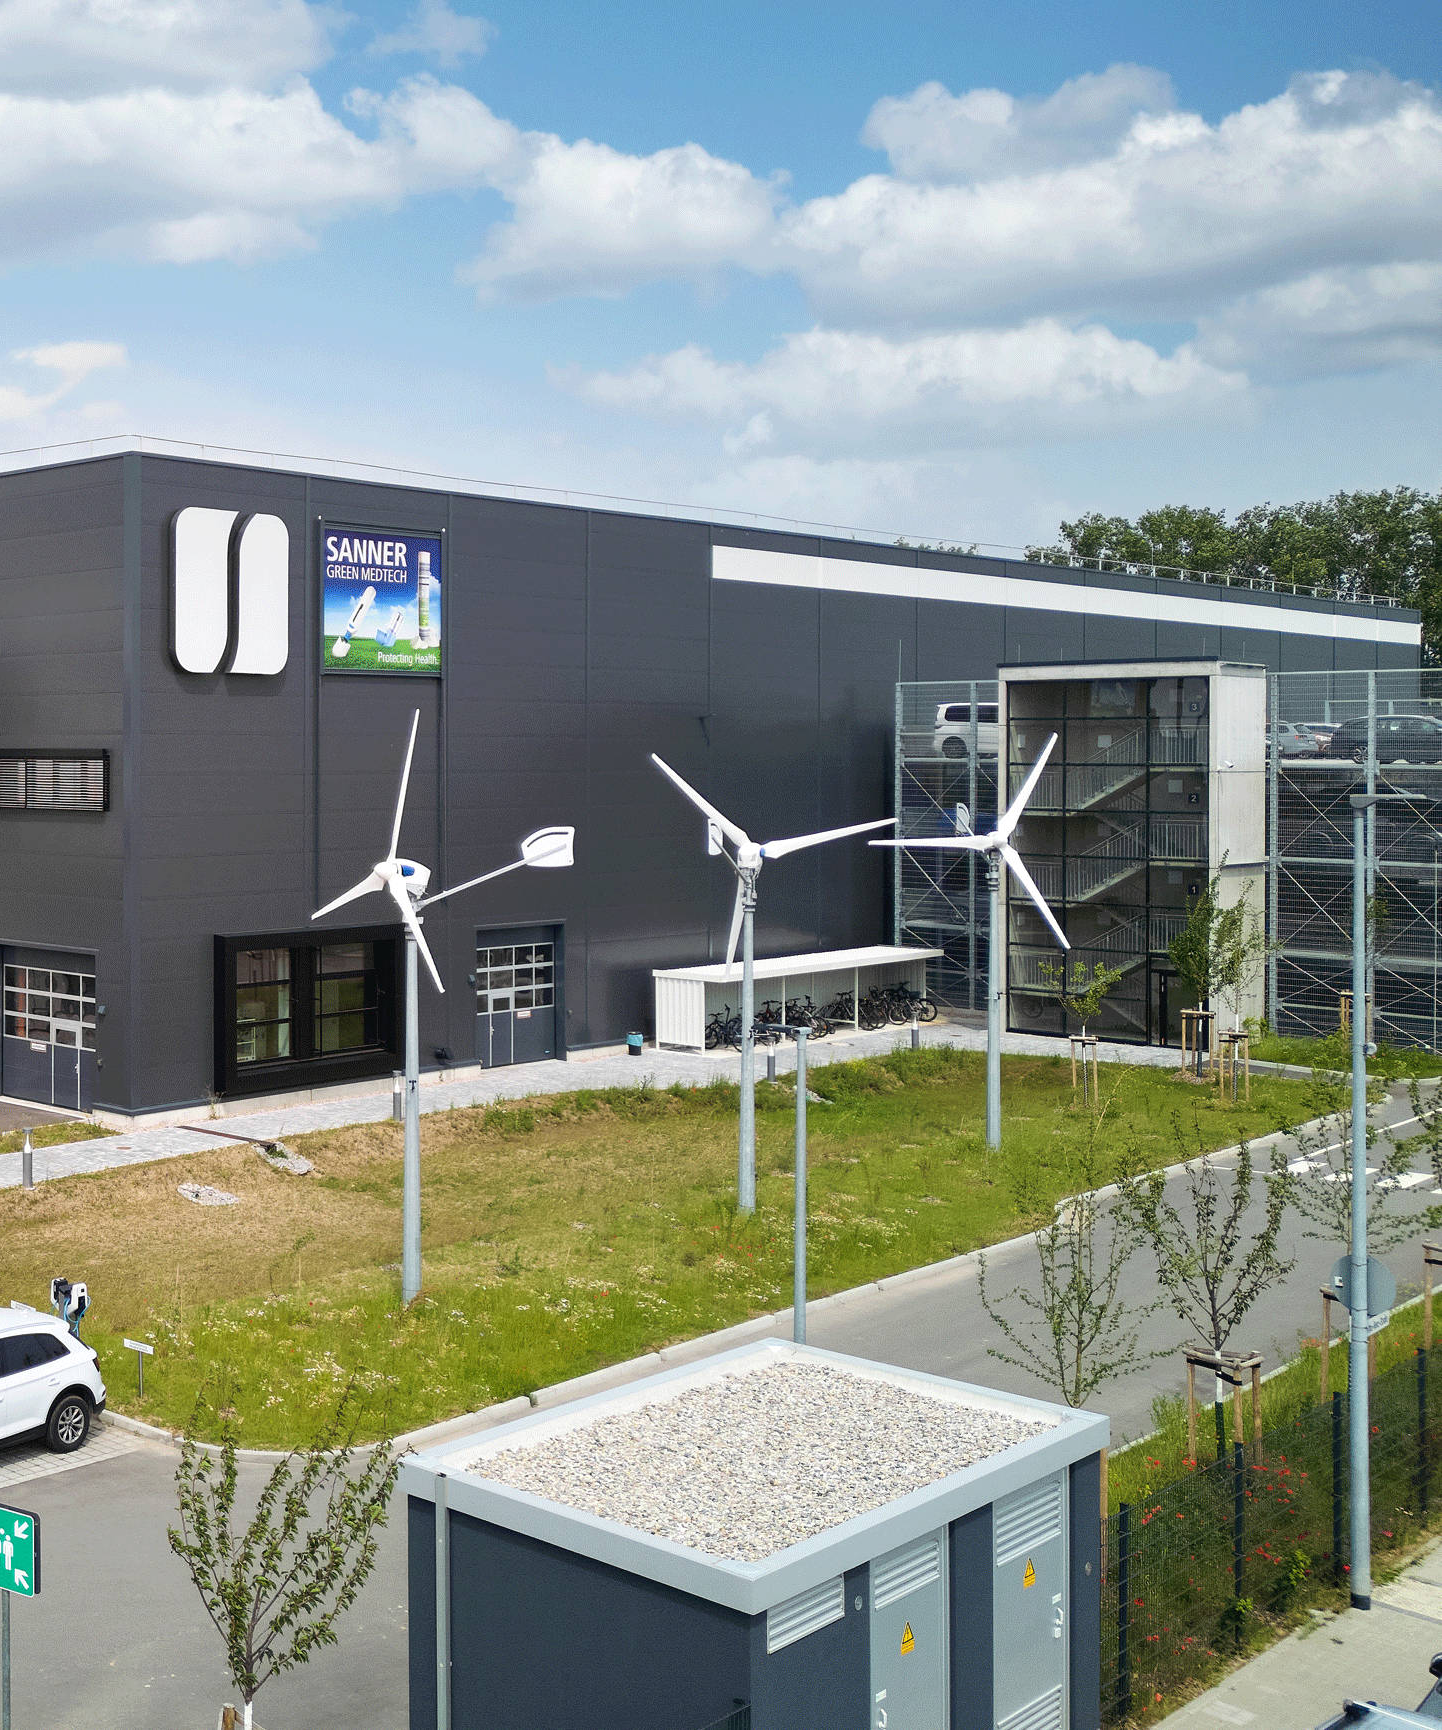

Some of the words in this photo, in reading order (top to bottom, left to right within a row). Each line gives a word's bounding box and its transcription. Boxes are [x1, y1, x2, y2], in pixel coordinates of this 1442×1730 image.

[327, 536, 407, 567] SANNER
[326, 564, 359, 580] GREEN
[361, 567, 407, 584] MEDTECH
[377, 651, 413, 667] Protecting
[1191, 703, 1198, 711] 3
[1191, 794, 1197, 803] 2
